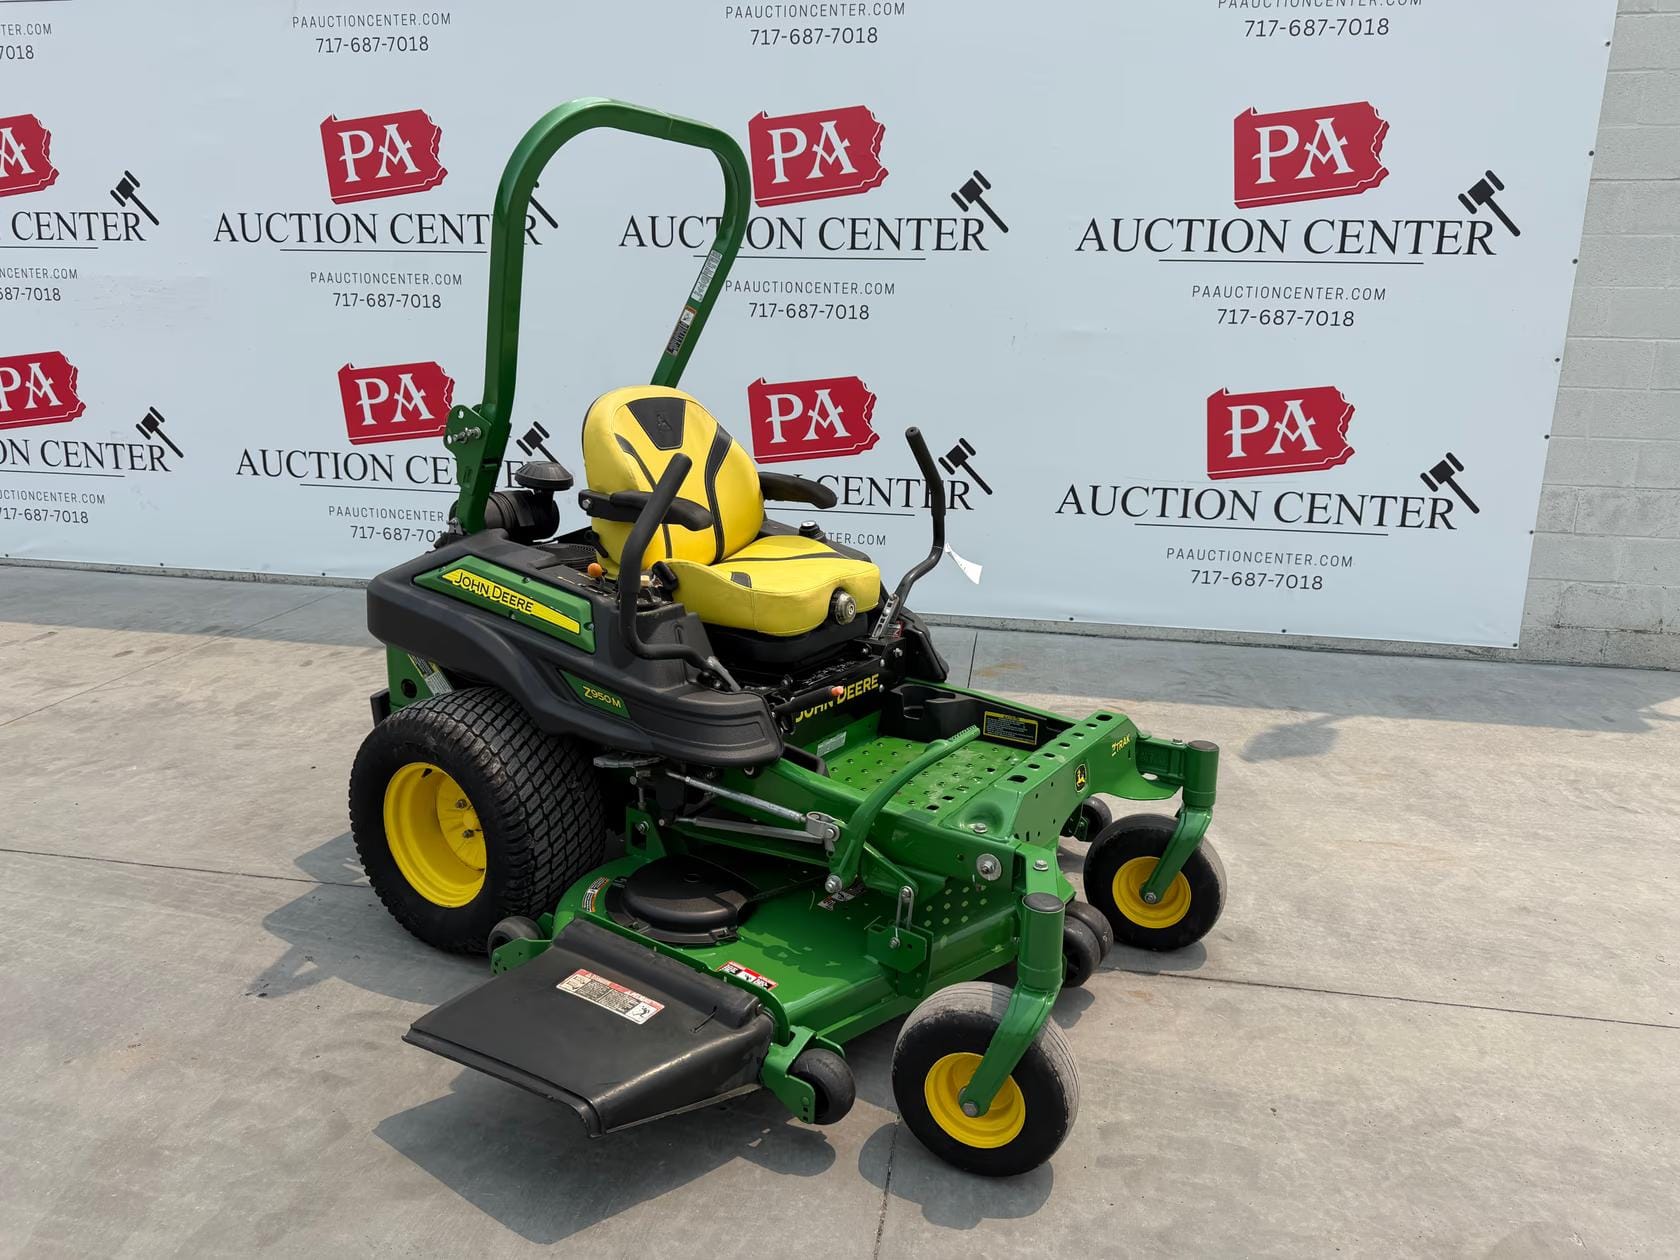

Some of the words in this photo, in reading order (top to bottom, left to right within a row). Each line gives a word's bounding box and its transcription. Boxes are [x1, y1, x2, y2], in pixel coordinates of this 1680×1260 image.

[293, 13, 450, 28] PAAUCTIONCENTER.COM
[726, 2, 904, 18] PAAUCTIONCENTER.COM
[750, 27, 877, 45] 717-687-7018
[1245, 18, 1389, 37] 717-687-7018
[316, 36, 428, 53] 717-687-7018
[338, 123, 420, 184] PA
[766, 120, 859, 184] PA
[1251, 117, 1355, 185] PA
[10, 210, 146, 243] CENTER
[213, 212, 378, 244] AUCTION
[388, 210, 543, 247] CENTR
[617, 215, 808, 250] AUCTON
[818, 216, 990, 252] CENTER
[1075, 218, 1291, 253] AUCTION
[1302, 217, 1500, 257] CENTER
[311, 272, 461, 285] PAAUCTIONCENTER.COM
[725, 278, 897, 297] PAAUCTIONCENTER.COM
[1192, 285, 1385, 300] PAAUCTIONCENTER.COM
[333, 293, 441, 308] 717-687-7018
[749, 303, 869, 320] 717-687-7018
[1217, 309, 1354, 326] 717-687-7018
[0, 363, 62, 411] PA
[355, 374, 434, 425] PA
[766, 389, 851, 443] PA
[1223, 399, 1322, 458] PA
[40, 438, 172, 473] CENTER
[236, 448, 394, 482] AUCTION
[1055, 484, 1262, 521] AUCTION
[1271, 490, 1457, 531] CENTER
[1167, 548, 1352, 567] PAAUCTIONCENTER.COM
[454, 572, 489, 597] JOHN
[491, 586, 534, 613] DEERE
[1191, 570, 1322, 590] 717-687-7018
[583, 685, 622, 709] Z950M
[837, 673, 880, 705] DEERE
